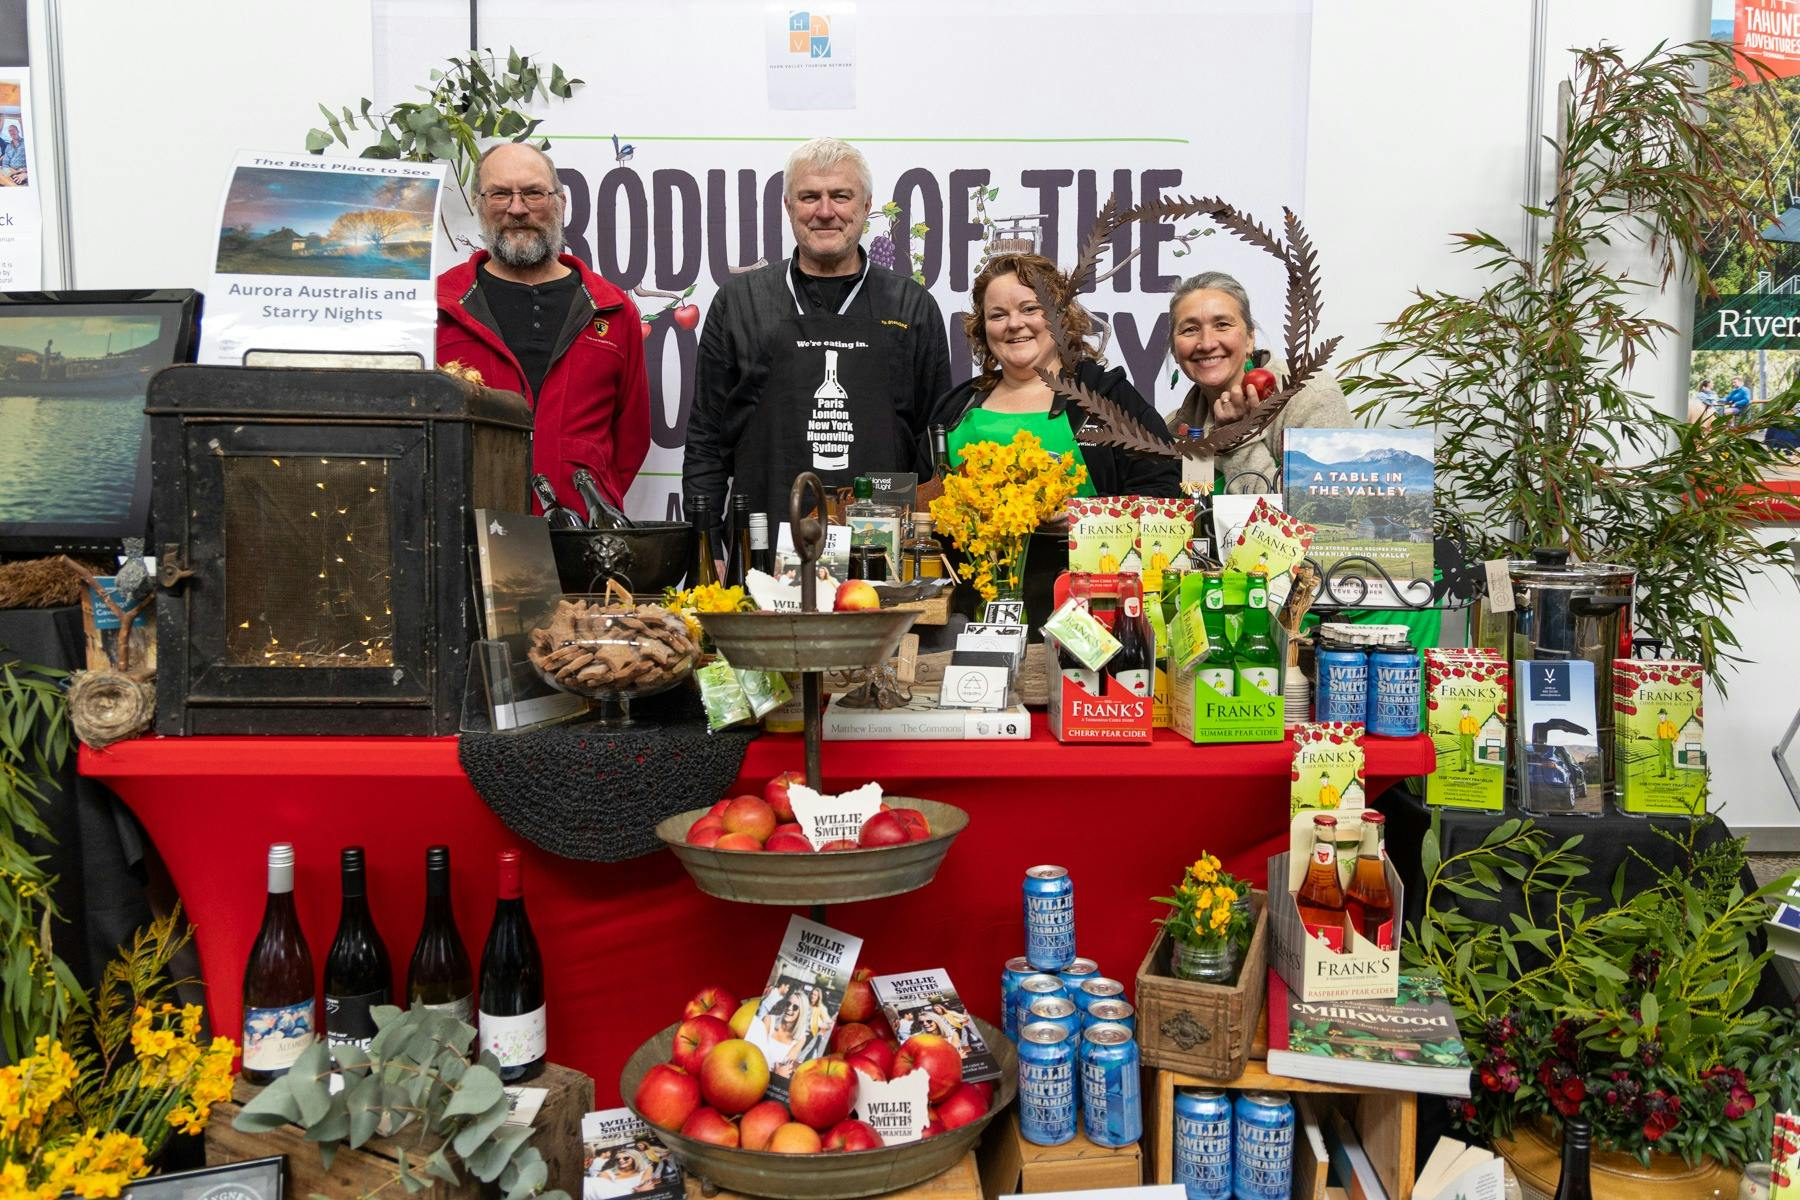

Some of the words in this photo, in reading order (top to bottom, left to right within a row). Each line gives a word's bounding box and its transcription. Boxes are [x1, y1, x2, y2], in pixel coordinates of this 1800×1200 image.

[1745, 7, 1800, 38] TAHUNE
[1744, 33, 1800, 54] ADVENTURES
[253, 158, 284, 167] The
[289, 160, 326, 169] Best
[332, 163, 375, 173] Place
[556, 167, 785, 292] RODU
[893, 168, 991, 292] OF
[1021, 168, 1183, 293] THE
[229, 283, 293, 297] Aurora
[298, 285, 378, 300] Australis
[384, 288, 416, 300] and
[262, 305, 318, 322] Starry
[324, 306, 383, 322] Nights
[823, 341, 854, 349] eating
[817, 399, 844, 409] Paris
[812, 409, 849, 420] London
[808, 420, 830, 430] New
[831, 421, 854, 431] York
[806, 431, 855, 442] Huonville
[812, 442, 849, 454] Sydney
[1313, 472, 1323, 481] A
[1329, 472, 1379, 482] TABLE
[1386, 473, 1403, 482] IN
[1309, 486, 1339, 496] THE
[1346, 486, 1407, 496] VALLEY
[1080, 522, 1133, 535] FRANK'S
[1143, 523, 1186, 535] RANK'S
[1251, 525, 1300, 558] FRANK'S
[1328, 665, 1367, 681] WILLI
[1377, 667, 1420, 683] WILLI
[1377, 681, 1420, 695] SMITH
[1441, 685, 1496, 699] FRANK'S
[1639, 689, 1694, 702] FRANK'S
[1072, 701, 1145, 717] FRANK'S
[1206, 701, 1276, 718] FRANK'S
[1329, 702, 1367, 715] NON-A
[831, 723, 866, 734] Matthew
[868, 724, 892, 734] Evans
[902, 724, 917, 734] The
[918, 724, 962, 734] Commons
[1068, 729, 1099, 737] CHERRY
[1101, 729, 1121, 737] PEAR
[1123, 730, 1147, 738] CIDER
[1256, 729, 1279, 737] CIDER
[1302, 750, 1356, 764] FRANK'S
[814, 813, 862, 826] WILLIE
[815, 826, 861, 837] SMITH
[1029, 922, 1074, 934] TASMANIA
[800, 930, 844, 956] WILLIE
[1029, 933, 1075, 948] NON-AL
[816, 963, 837, 977] SHED
[1317, 957, 1390, 977] FRANK'S
[891, 976, 936, 987] WILLIE
[1308, 988, 1350, 997] RASPBERRY
[1371, 986, 1395, 994] CIDER
[1292, 1003, 1449, 1027] Milkwood
[1083, 1064, 1106, 1081] LIE
[1023, 1093, 1073, 1107] ASMANIAN
[867, 1102, 912, 1115] WILLIE
[1023, 1104, 1073, 1121] ON-ALC
[600, 1117, 642, 1128] WILLI
[601, 1122, 647, 1134] SMITH
[1176, 1117, 1230, 1137] WILLIE
[878, 1129, 913, 1137] SMANIAN
[1237, 1121, 1291, 1143] WILLIE
[1180, 1152, 1230, 1165] ASMANIA
[1182, 1162, 1229, 1179] ON-AL
[1241, 1164, 1289, 1185] ON-AL
